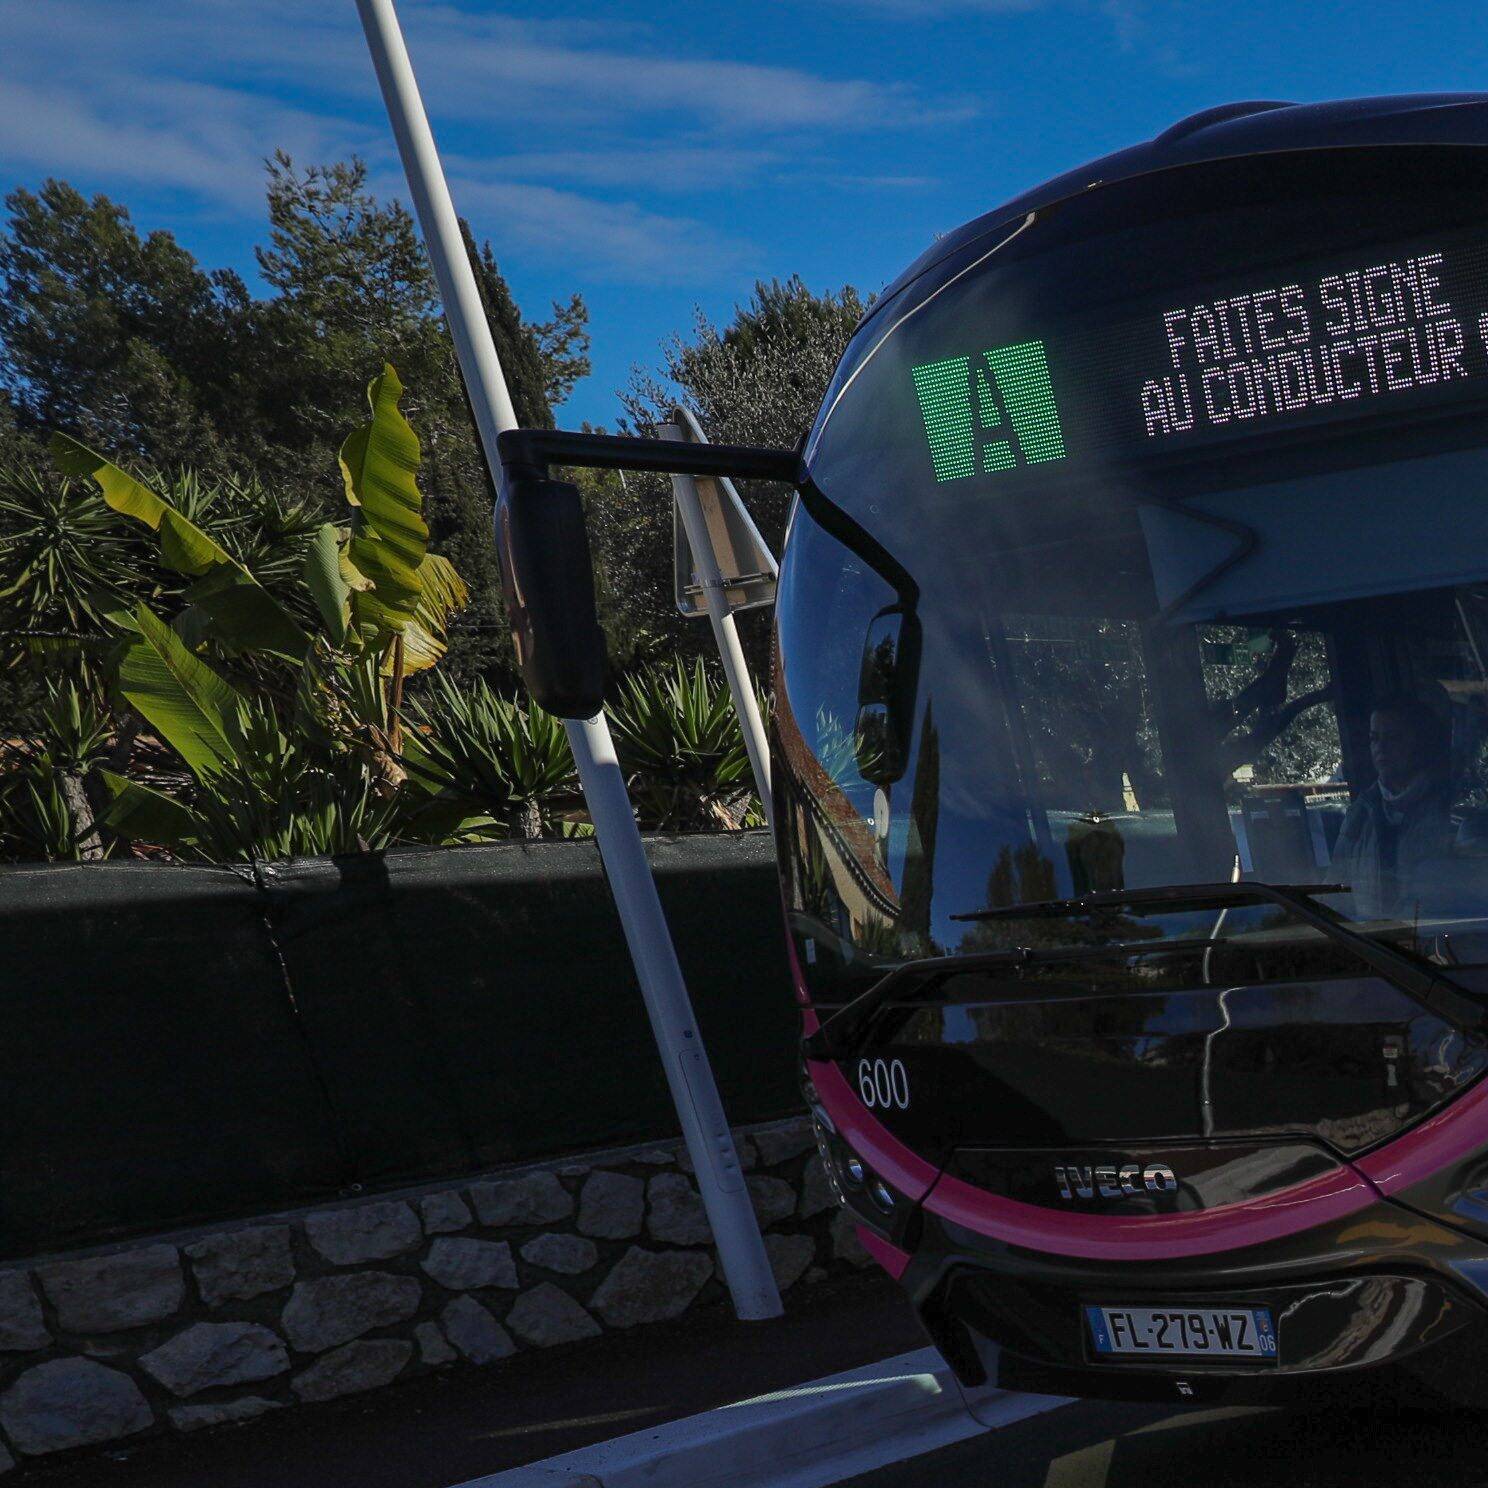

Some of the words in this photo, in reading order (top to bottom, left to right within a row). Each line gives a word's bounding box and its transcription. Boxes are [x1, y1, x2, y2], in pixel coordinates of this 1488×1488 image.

[1163, 284, 1312, 370] FAITES
[1319, 253, 1452, 337] SIGNE
[1140, 373, 1196, 437] AU
[1202, 318, 1469, 426] CONDUCTEUR
[857, 1058, 910, 1110] 600
[1054, 1163, 1179, 1199] IVECO
[1258, 1334, 1277, 1352] 06
